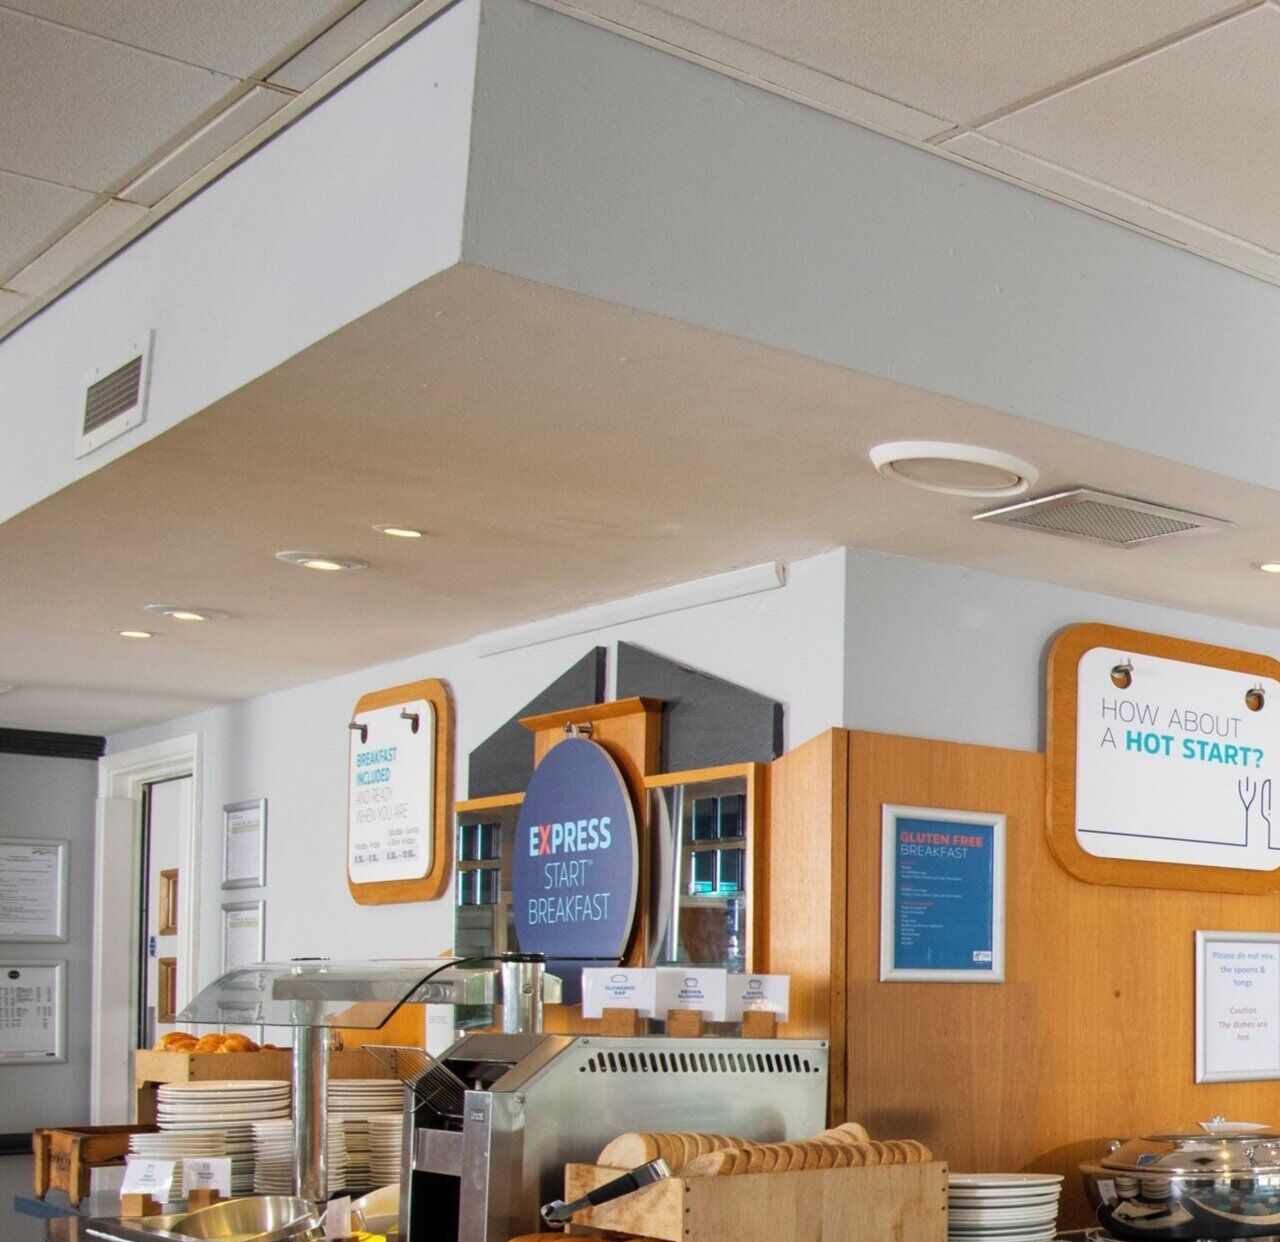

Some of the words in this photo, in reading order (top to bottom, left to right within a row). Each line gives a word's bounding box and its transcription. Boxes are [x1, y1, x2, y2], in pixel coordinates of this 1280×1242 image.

[1102, 698, 1159, 726] HOW
[1168, 709, 1242, 738] ABOUT
[1101, 727, 1117, 749] A
[1126, 730, 1174, 756] HOT
[1182, 738, 1264, 768] START?
[356, 747, 397, 767] BREAKFAST
[356, 768, 391, 786] INCLUDED
[529, 816, 612, 857] EXPRESS
[900, 831, 949, 846] GLUTEN
[953, 835, 984, 848] FREE
[900, 844, 968, 859] BREAKFAST
[528, 892, 611, 925] BREAKFAST
[1212, 951, 1235, 959] Please
[1260, 952, 1274, 960] mix
[1234, 967, 1258, 975] spoons
[1233, 979, 1253, 988] tongs
[1229, 1007, 1257, 1015] Caution
[1219, 1021, 1231, 1029] The
[1233, 1020, 1255, 1029] dishes
